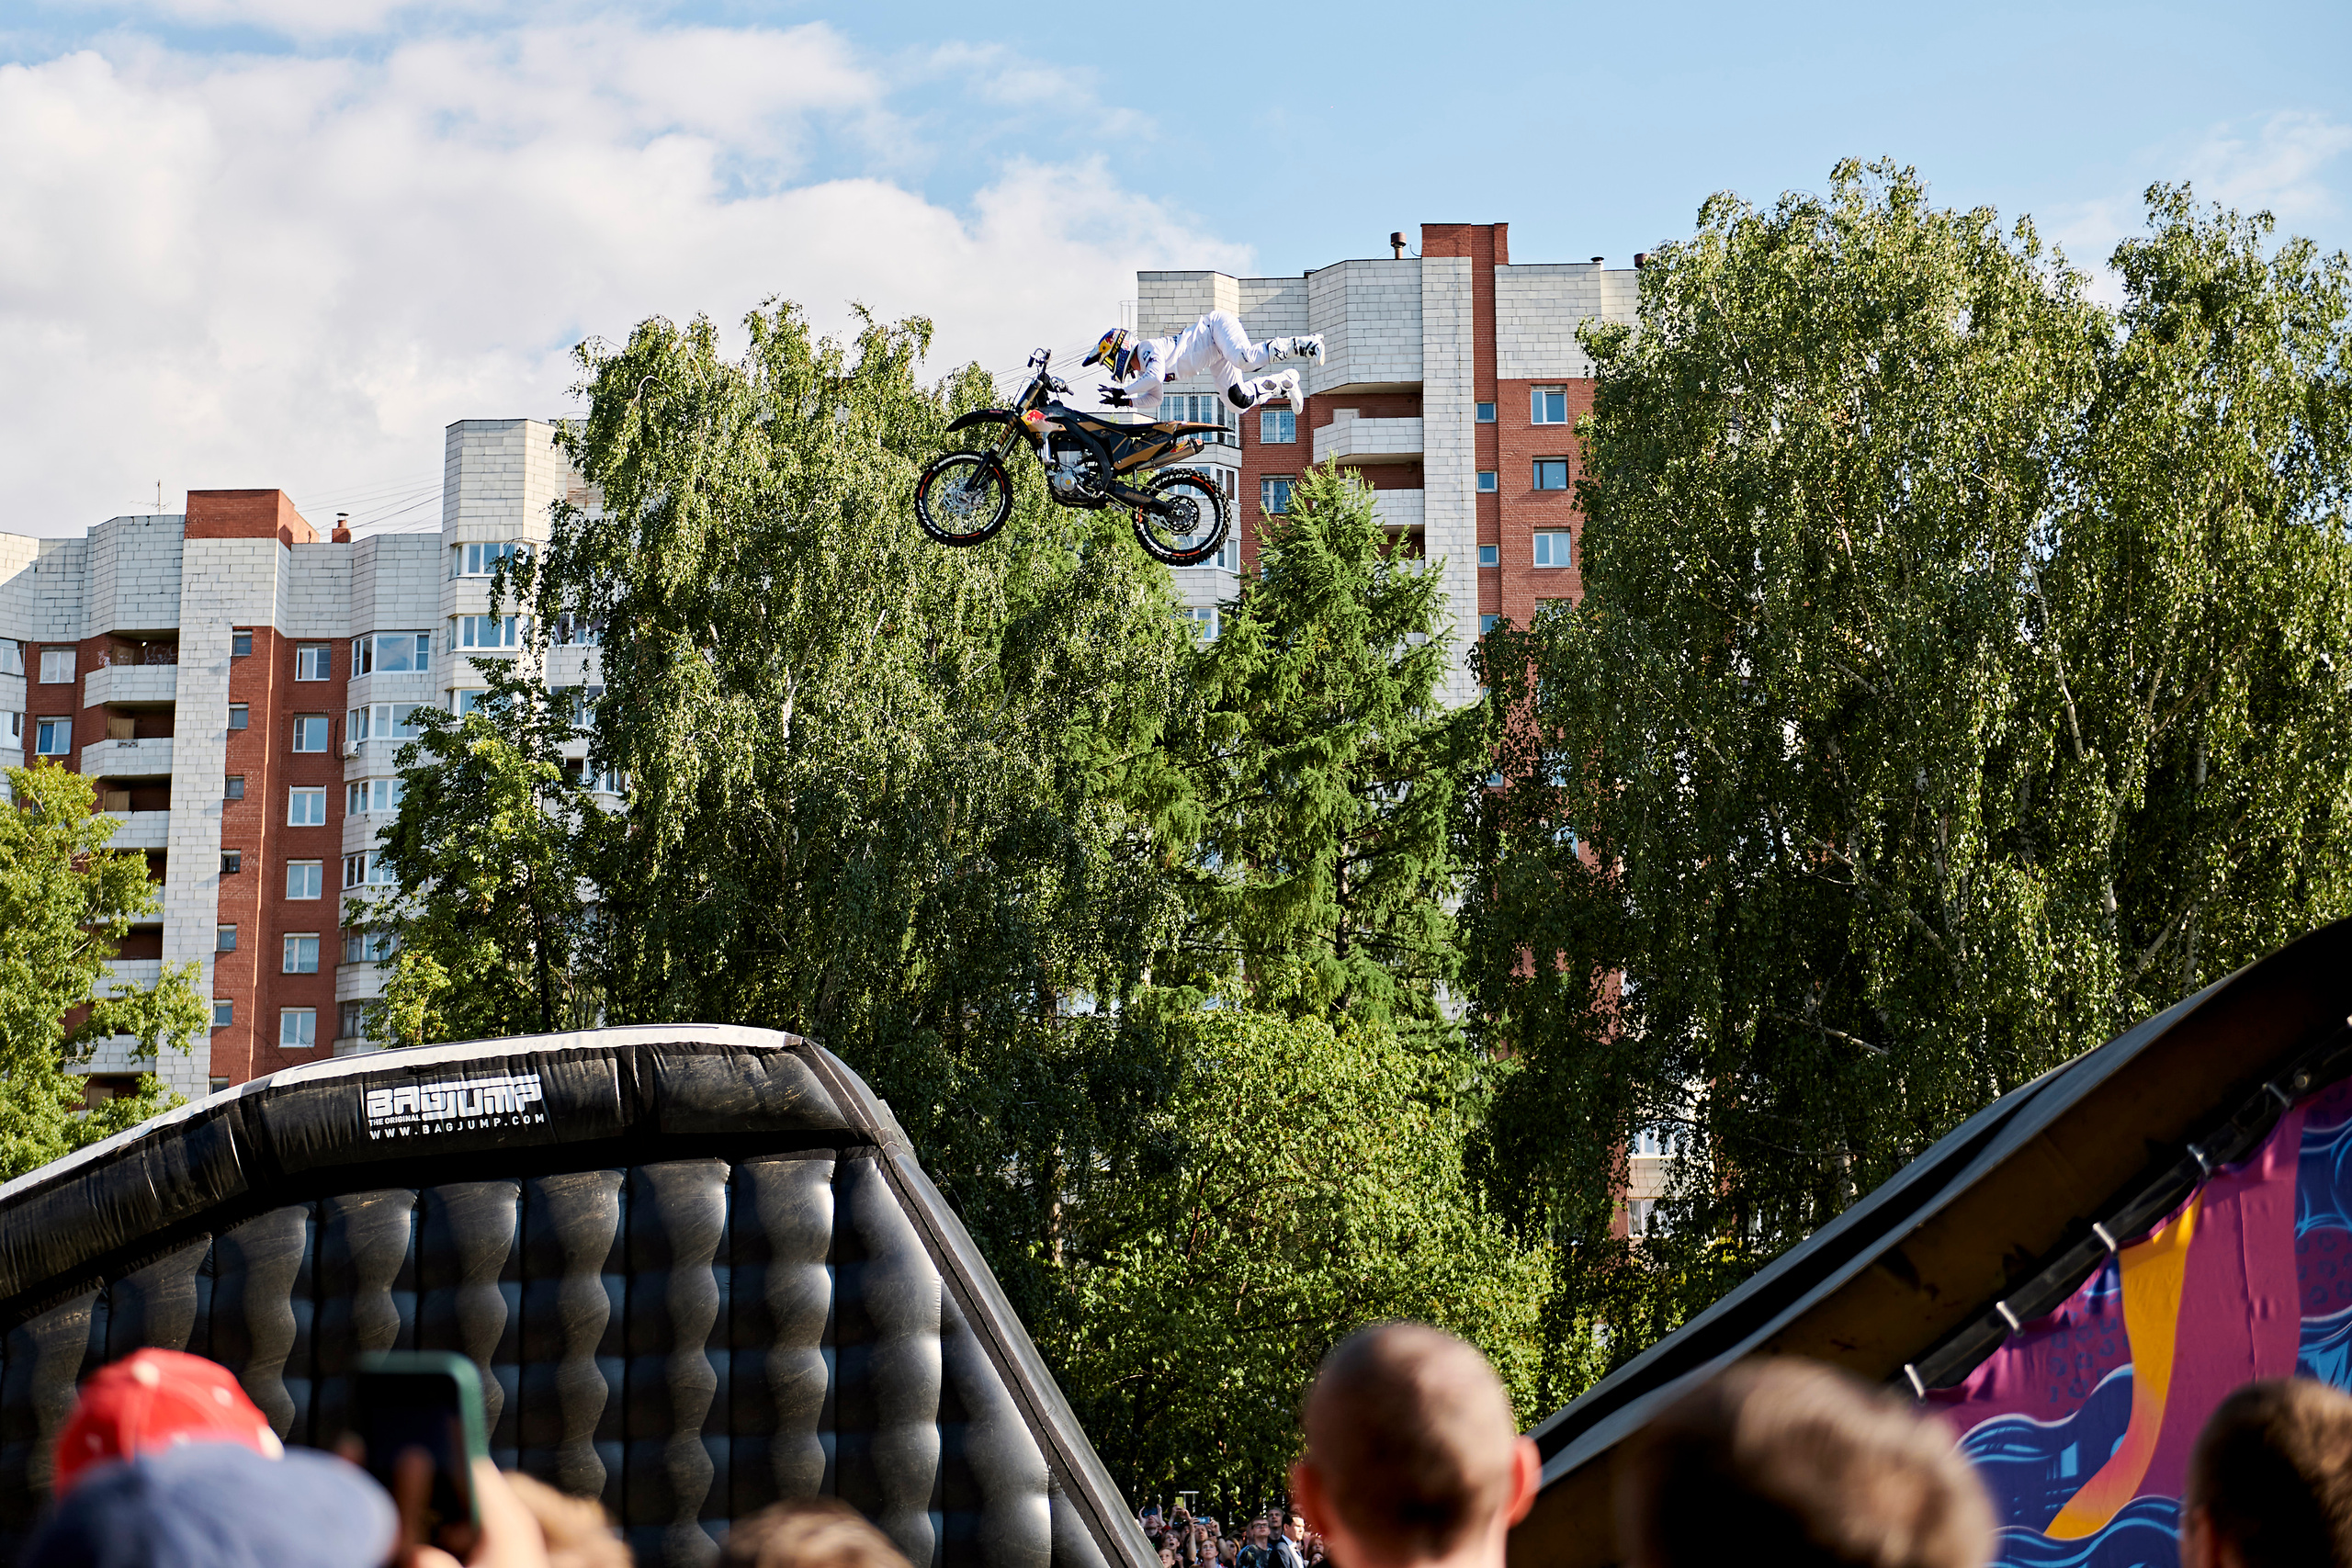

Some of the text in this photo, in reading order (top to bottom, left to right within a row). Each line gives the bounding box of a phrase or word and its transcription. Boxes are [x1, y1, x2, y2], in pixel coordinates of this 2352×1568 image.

[367, 1074, 542, 1121] BAGJUMP
[368, 1114, 421, 1127] THE ORIGINAL
[369, 1113, 545, 1140] WWW.BAGJUMP.COM
